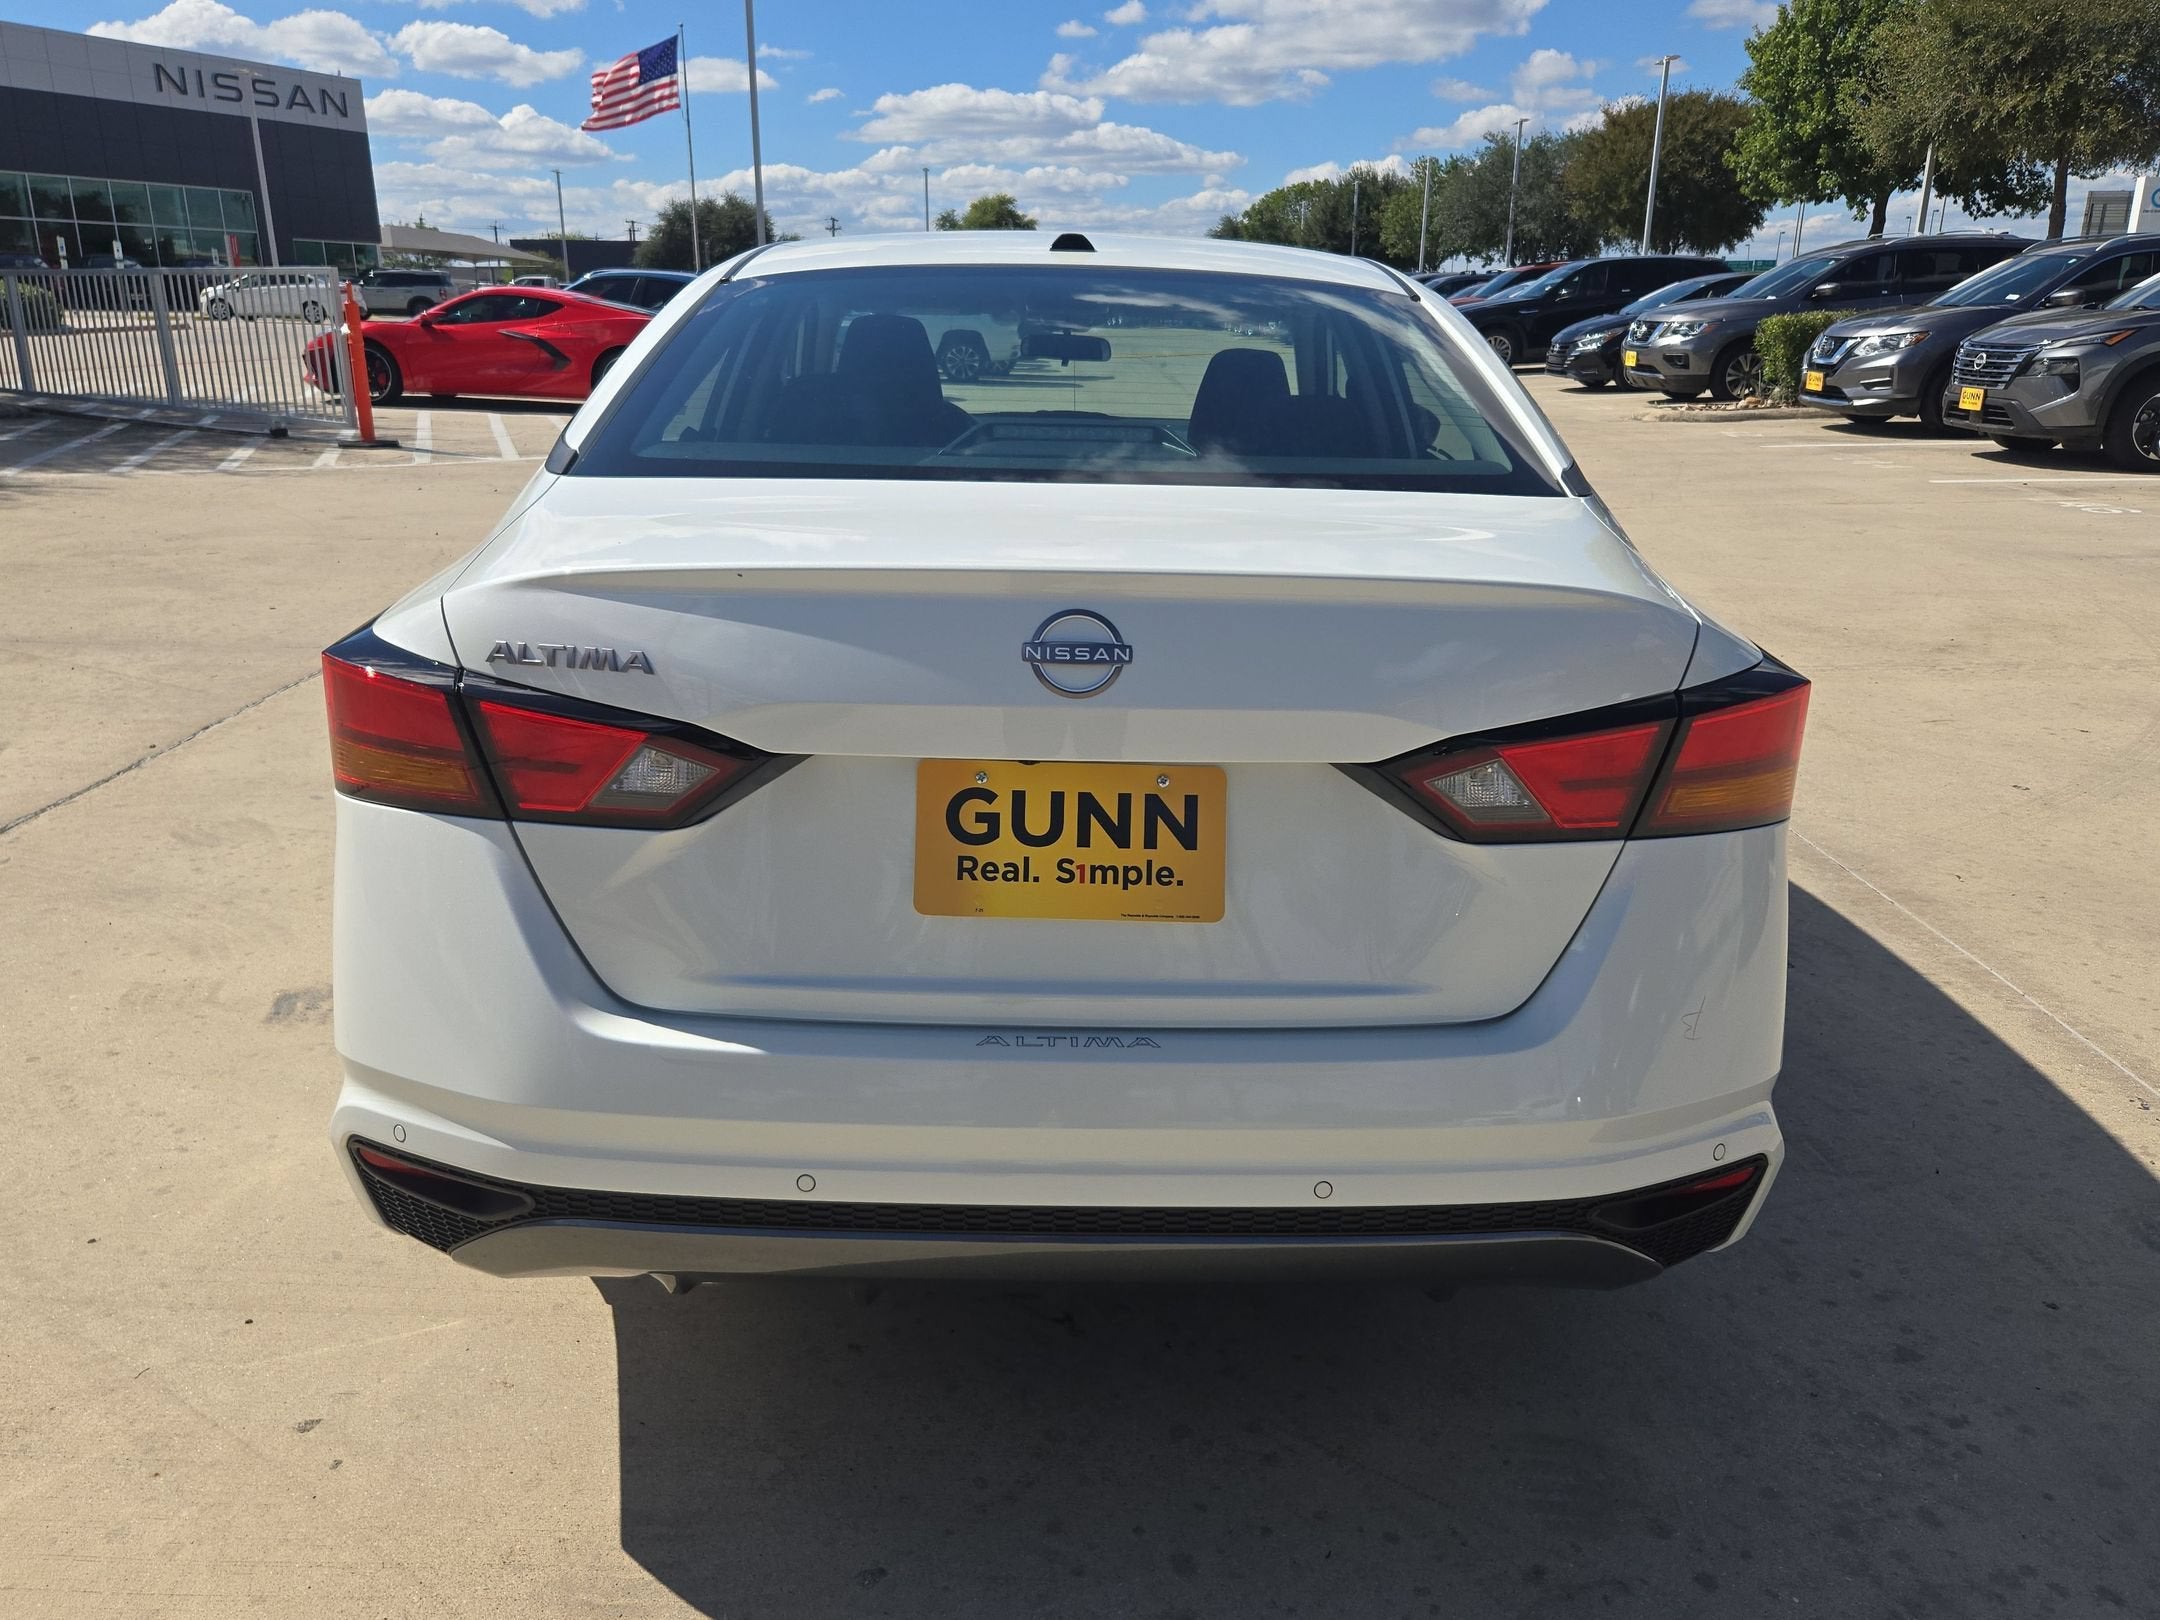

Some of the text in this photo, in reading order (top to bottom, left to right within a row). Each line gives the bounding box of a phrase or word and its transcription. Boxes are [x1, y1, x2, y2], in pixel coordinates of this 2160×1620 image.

[153, 62, 349, 118] NISSAN
[1962, 391, 1982, 401] GUNN
[485, 640, 655, 675] ALTIMA
[1025, 646, 1130, 661] NISSAN
[945, 787, 1199, 851] GUNN
[956, 855, 1040, 883] Real.
[975, 1035, 1162, 1048] ALTIMA
